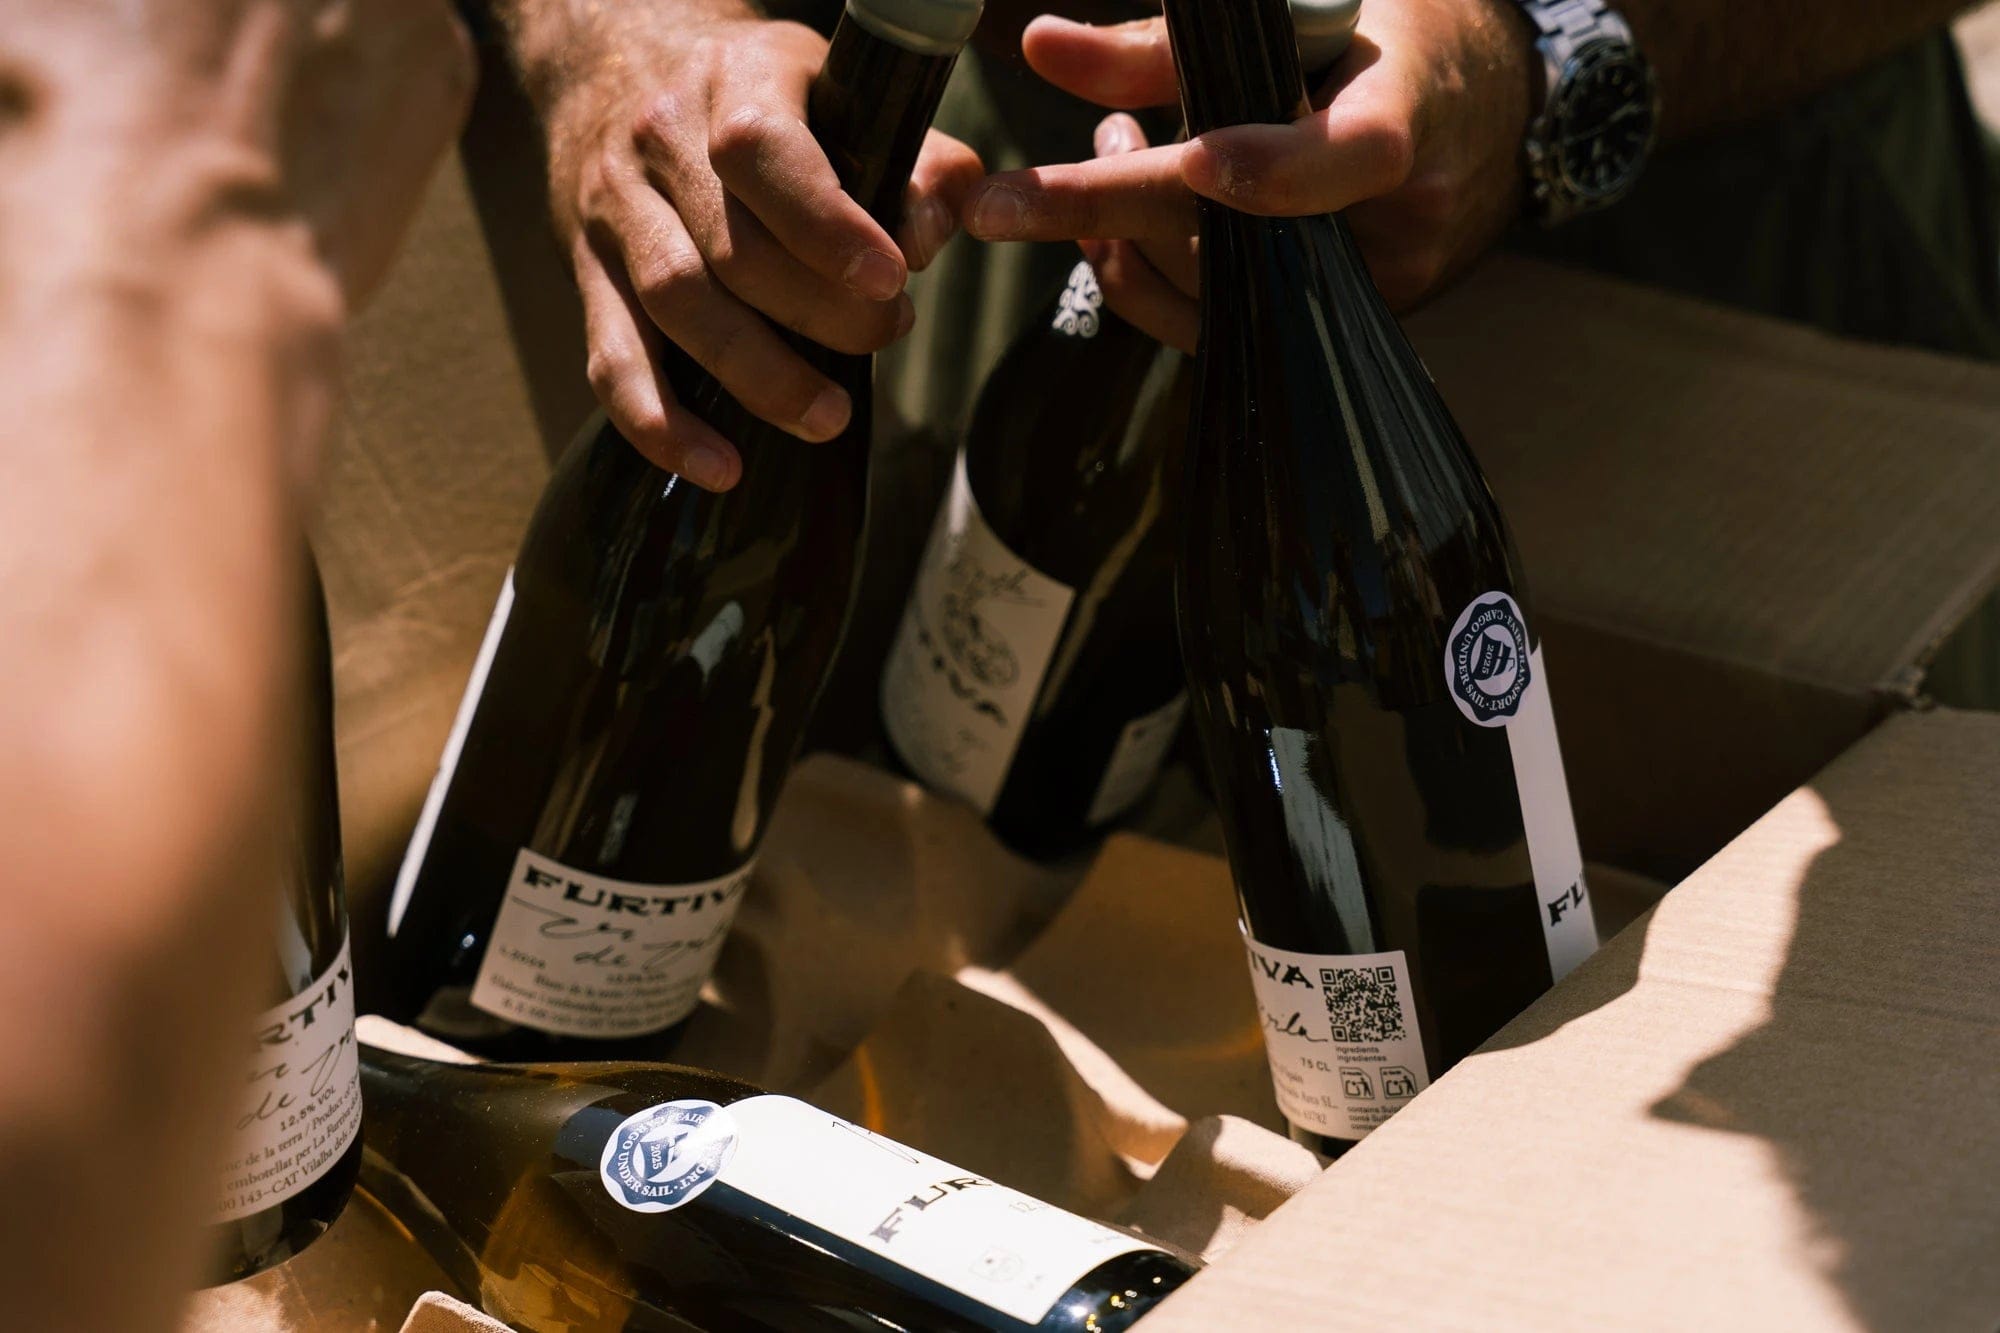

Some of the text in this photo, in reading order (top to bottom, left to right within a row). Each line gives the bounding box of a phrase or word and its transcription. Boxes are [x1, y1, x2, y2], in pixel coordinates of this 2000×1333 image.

[1458, 609, 1504, 708] CARGO UNDER SAIL
[1482, 644, 1494, 674] 2025
[1316, 1060, 1332, 1072] CL
[294, 1144, 312, 1166] per
[650, 1143, 663, 1170] 2025
[617, 1151, 641, 1193] UNDER
[641, 1183, 674, 1197] SAIL
[869, 1177, 992, 1243] FUR
